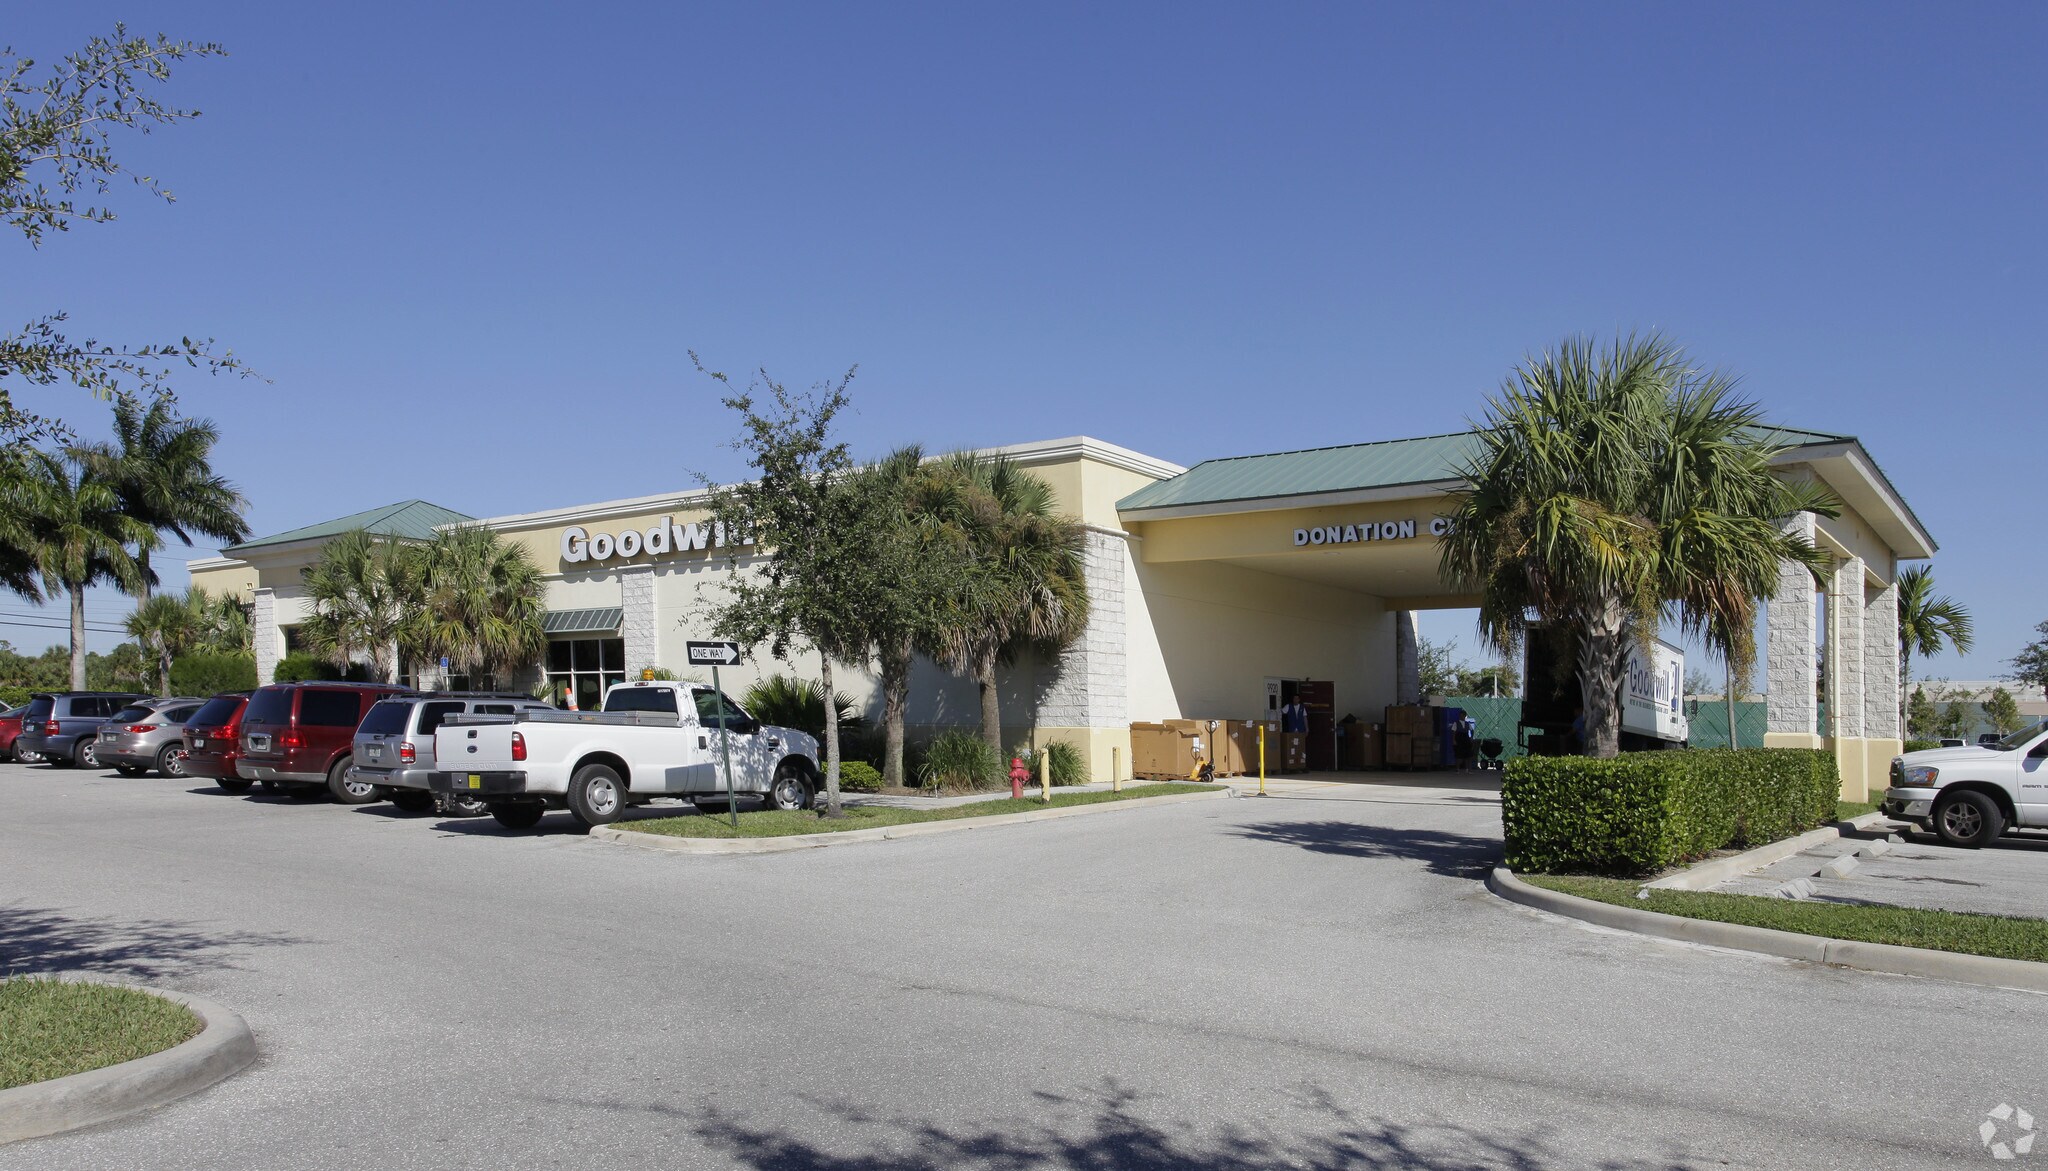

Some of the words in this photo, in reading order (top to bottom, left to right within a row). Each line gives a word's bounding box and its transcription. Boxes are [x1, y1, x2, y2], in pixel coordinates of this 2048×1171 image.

[560, 508, 754, 563] Goodwi
[1293, 520, 1415, 546] DONATION
[693, 648, 707, 658] ONE
[709, 649, 724, 658] WAY
